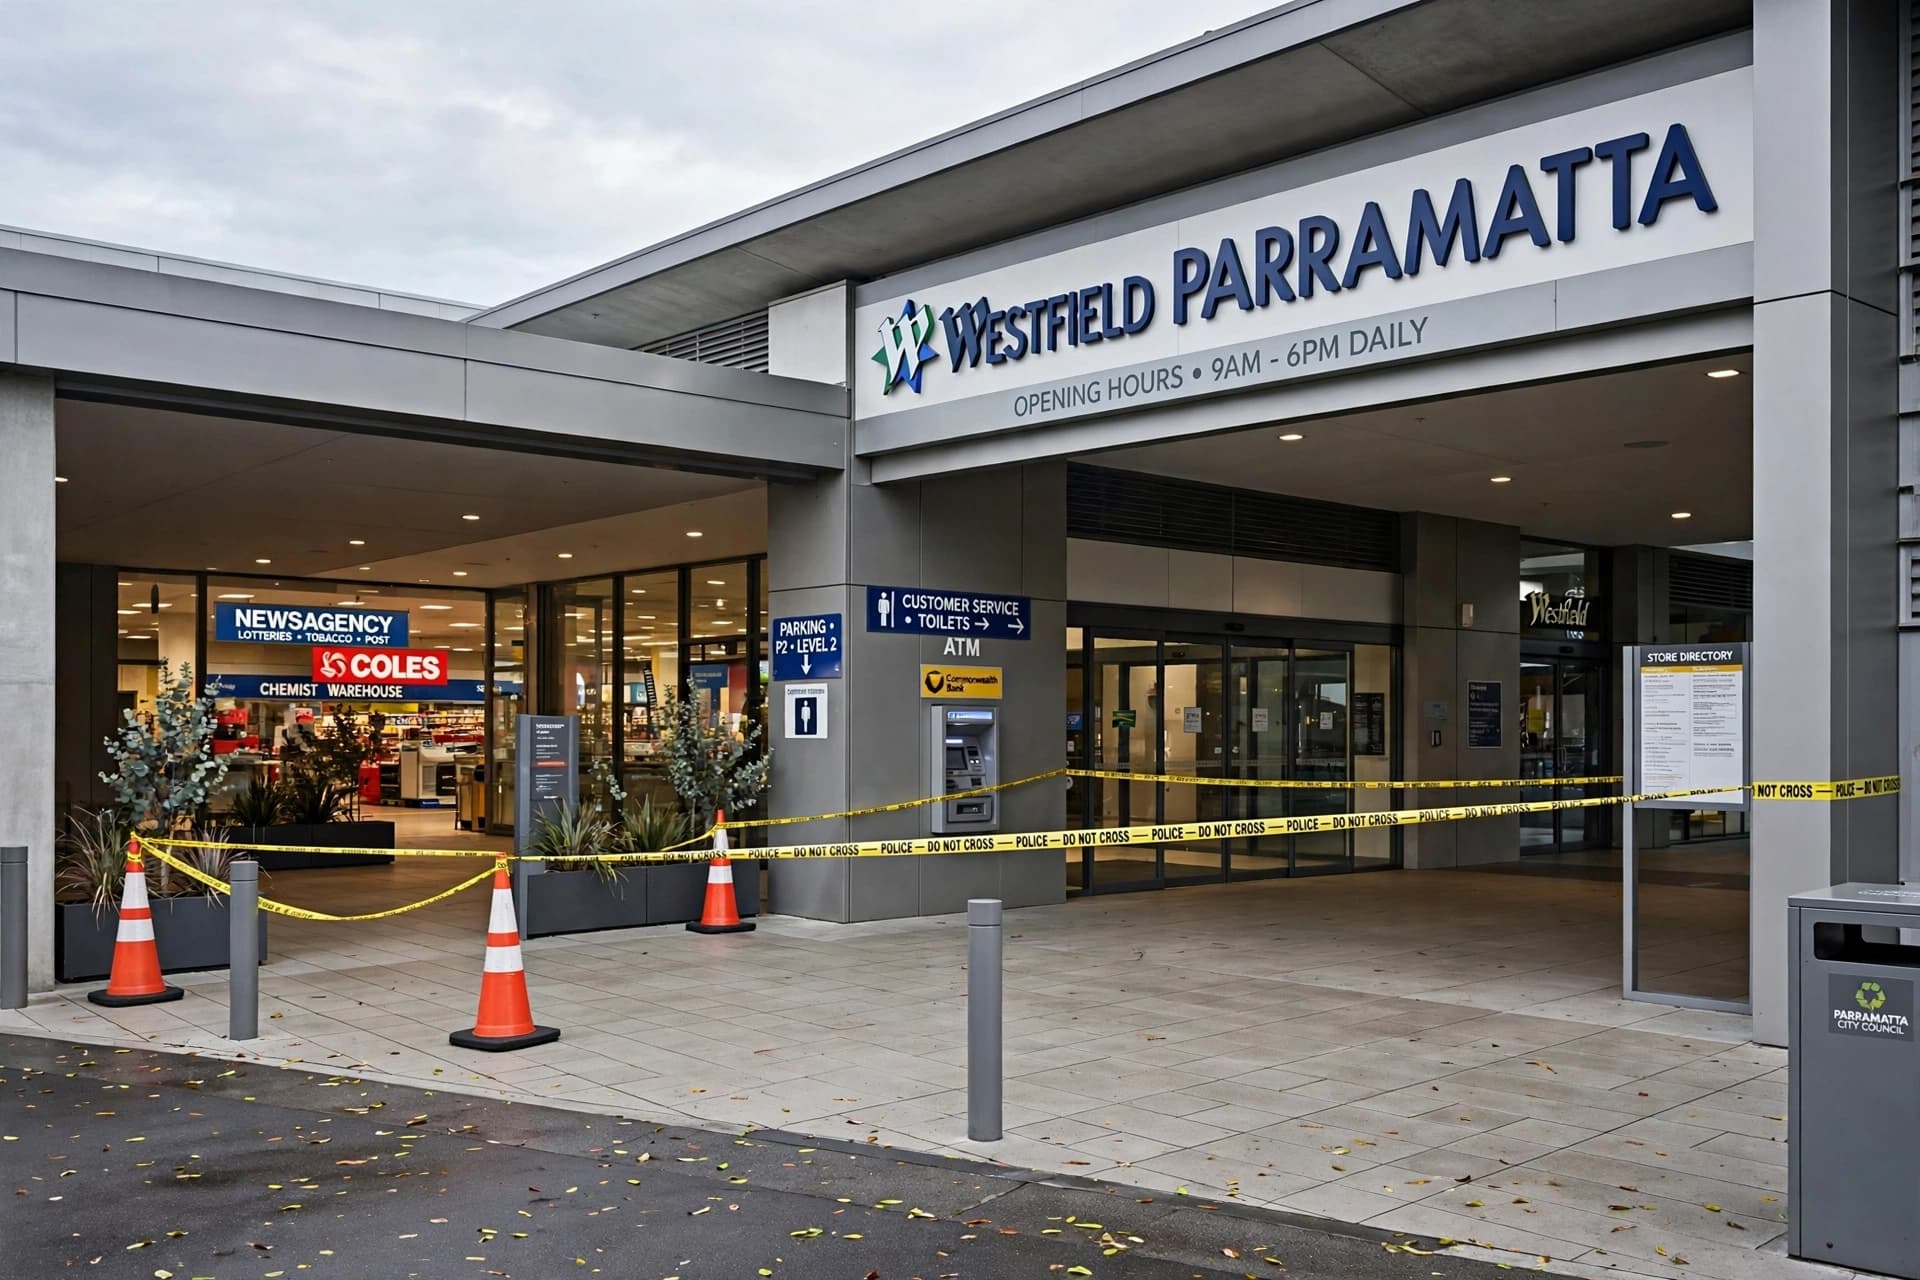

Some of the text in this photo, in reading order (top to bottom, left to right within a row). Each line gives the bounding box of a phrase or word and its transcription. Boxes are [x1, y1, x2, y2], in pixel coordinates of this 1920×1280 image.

[938, 123, 1719, 373] WESTFIELD PARRAMATTA
[1014, 381, 1101, 417] OPENING
[1108, 364, 1183, 400] HOURS
[1211, 350, 1261, 381] 9AM
[1287, 335, 1340, 367] 6PM
[1350, 316, 1429, 356] DAILY
[902, 594, 1019, 616] CUSTOMER SERVICE
[235, 608, 393, 634] NEWSAGENCY
[780, 618, 826, 636] PARKING
[918, 613, 970, 630] TOILETS
[238, 630, 390, 645] LOTTERIES TOBACCO POST
[776, 637, 837, 655] P2 LEVEL 2
[943, 637, 981, 657] ATM
[1647, 650, 1733, 663] STORE DIRECTORY
[350, 653, 440, 680] COLES
[260, 682, 403, 699] CHEMIST WAREHOUSE
[749, 848, 779, 858] POLICE
[794, 847, 807, 857] DO
[809, 846, 827, 857] NOT
[829, 844, 859, 856] CROSS
[881, 842, 912, 854] POLICE
[927, 840, 941, 852] DO
[943, 839, 961, 851] NOT
[964, 837, 994, 850] CROSS
[1016, 835, 1048, 848] POLICE
[1063, 834, 1076, 846] DO
[1078, 832, 1096, 844] NOT
[1099, 830, 1130, 843] CROSS
[1151, 828, 1183, 841] POLICE
[1198, 825, 1211, 838] DO
[1214, 823, 1233, 837] NOT
[1235, 821, 1265, 835] CROSS
[1286, 818, 1319, 832] POLICE
[1333, 815, 1346, 829] DO
[1348, 814, 1366, 827] NOT
[1368, 813, 1398, 825] CROSS
[1419, 809, 1450, 822] POLICE
[1465, 807, 1477, 819] DO
[1480, 806, 1497, 817] NOT
[1500, 803, 1530, 816] CROSS
[1758, 784, 1778, 797] NOT
[1780, 784, 1813, 798] CROSS
[1836, 783, 1855, 797] POLICE
[1864, 780, 1872, 794] DO
[1873, 779, 1883, 793] NOT
[1833, 1009, 1909, 1026] PARRAMATTA
[1837, 1020, 1905, 1035] CITY COUNCIL
